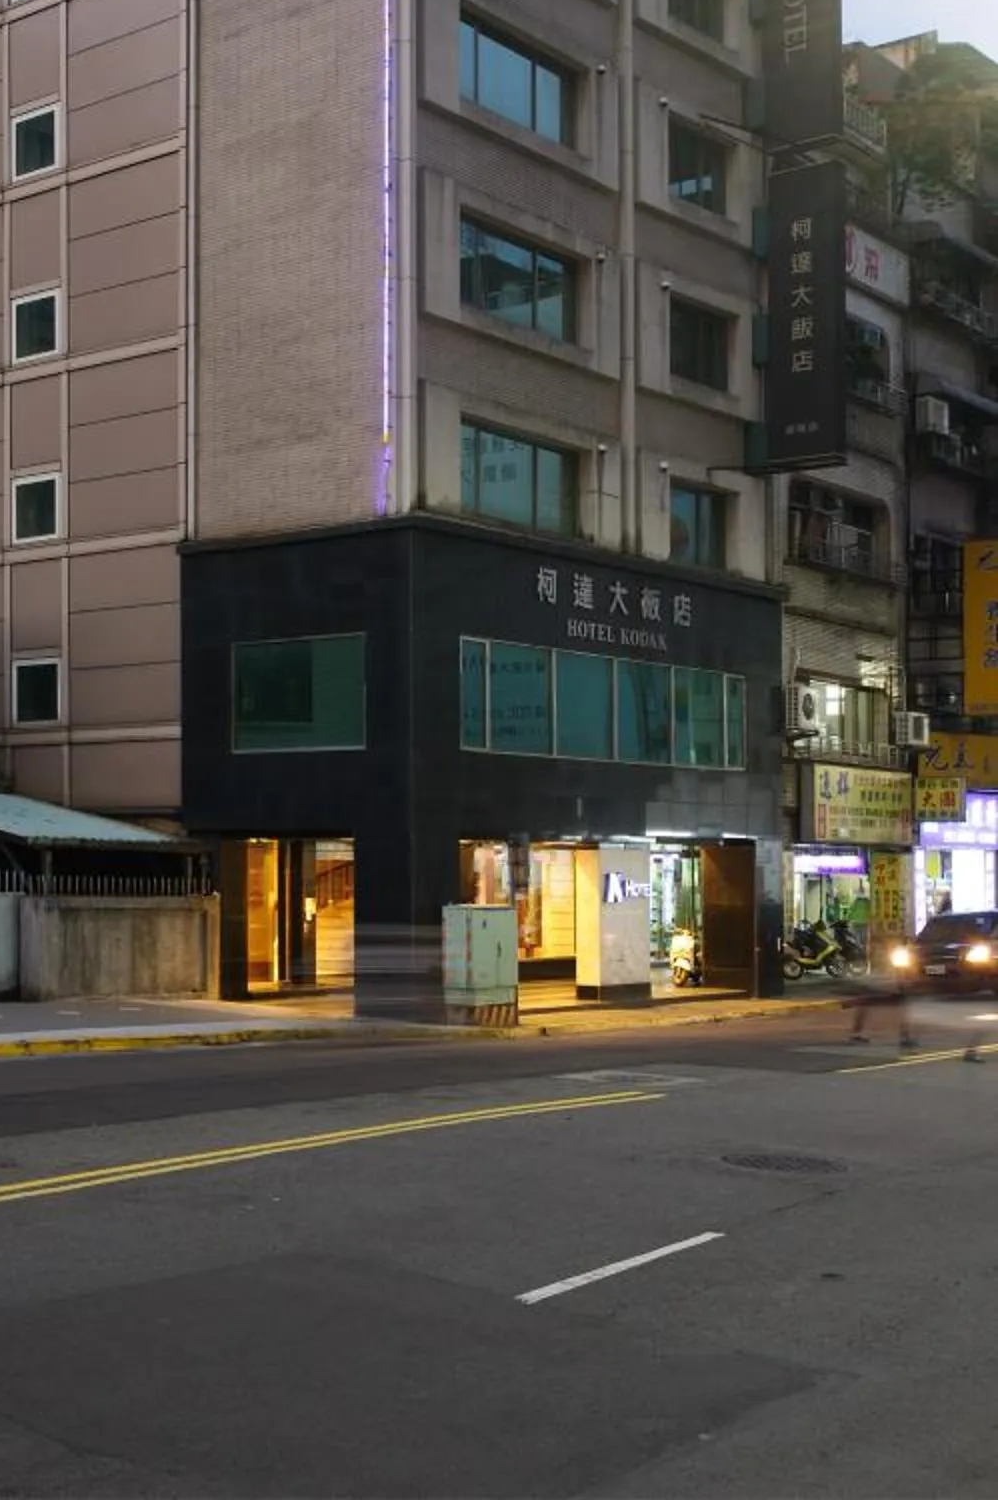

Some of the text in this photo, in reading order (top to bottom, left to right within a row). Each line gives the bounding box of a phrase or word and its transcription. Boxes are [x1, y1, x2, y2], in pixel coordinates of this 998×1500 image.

[790, 216, 814, 373] 柯達大飯店
[537, 565, 692, 627] 柯達大飯店
[567, 618, 667, 650] HOTEL KODAK
